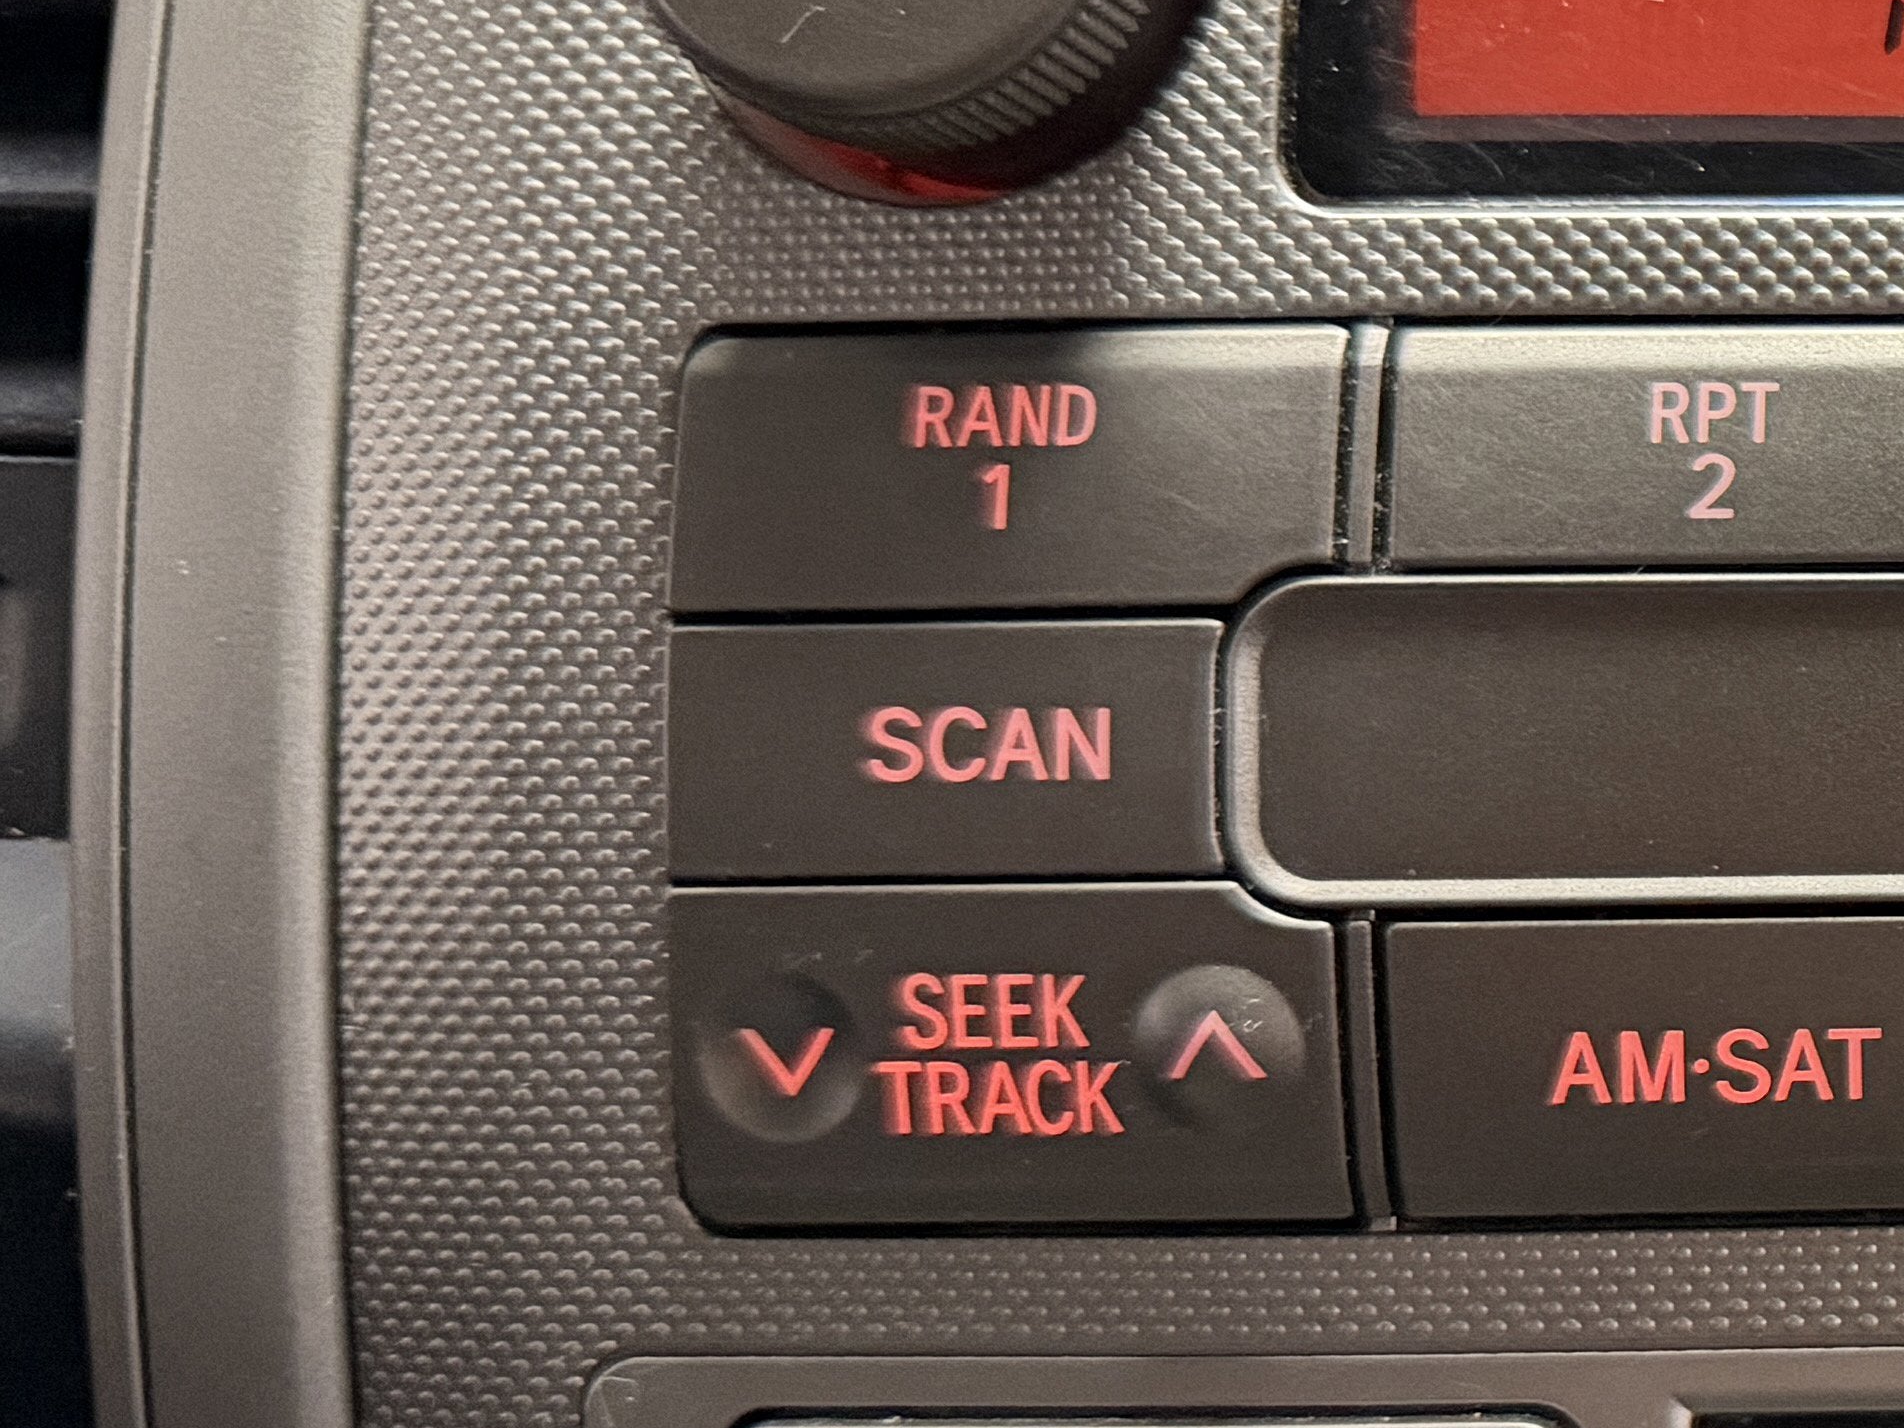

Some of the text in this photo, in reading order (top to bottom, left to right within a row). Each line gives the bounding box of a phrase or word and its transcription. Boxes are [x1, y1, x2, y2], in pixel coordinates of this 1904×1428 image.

[906, 382, 1098, 448] RAND
[1649, 381, 1780, 444] RPT
[980, 464, 1011, 530] 1
[1687, 453, 1736, 519] 2
[858, 706, 1112, 783] SCAN
[896, 972, 1090, 1049] SEEK
[870, 1059, 1125, 1134] TRACK
